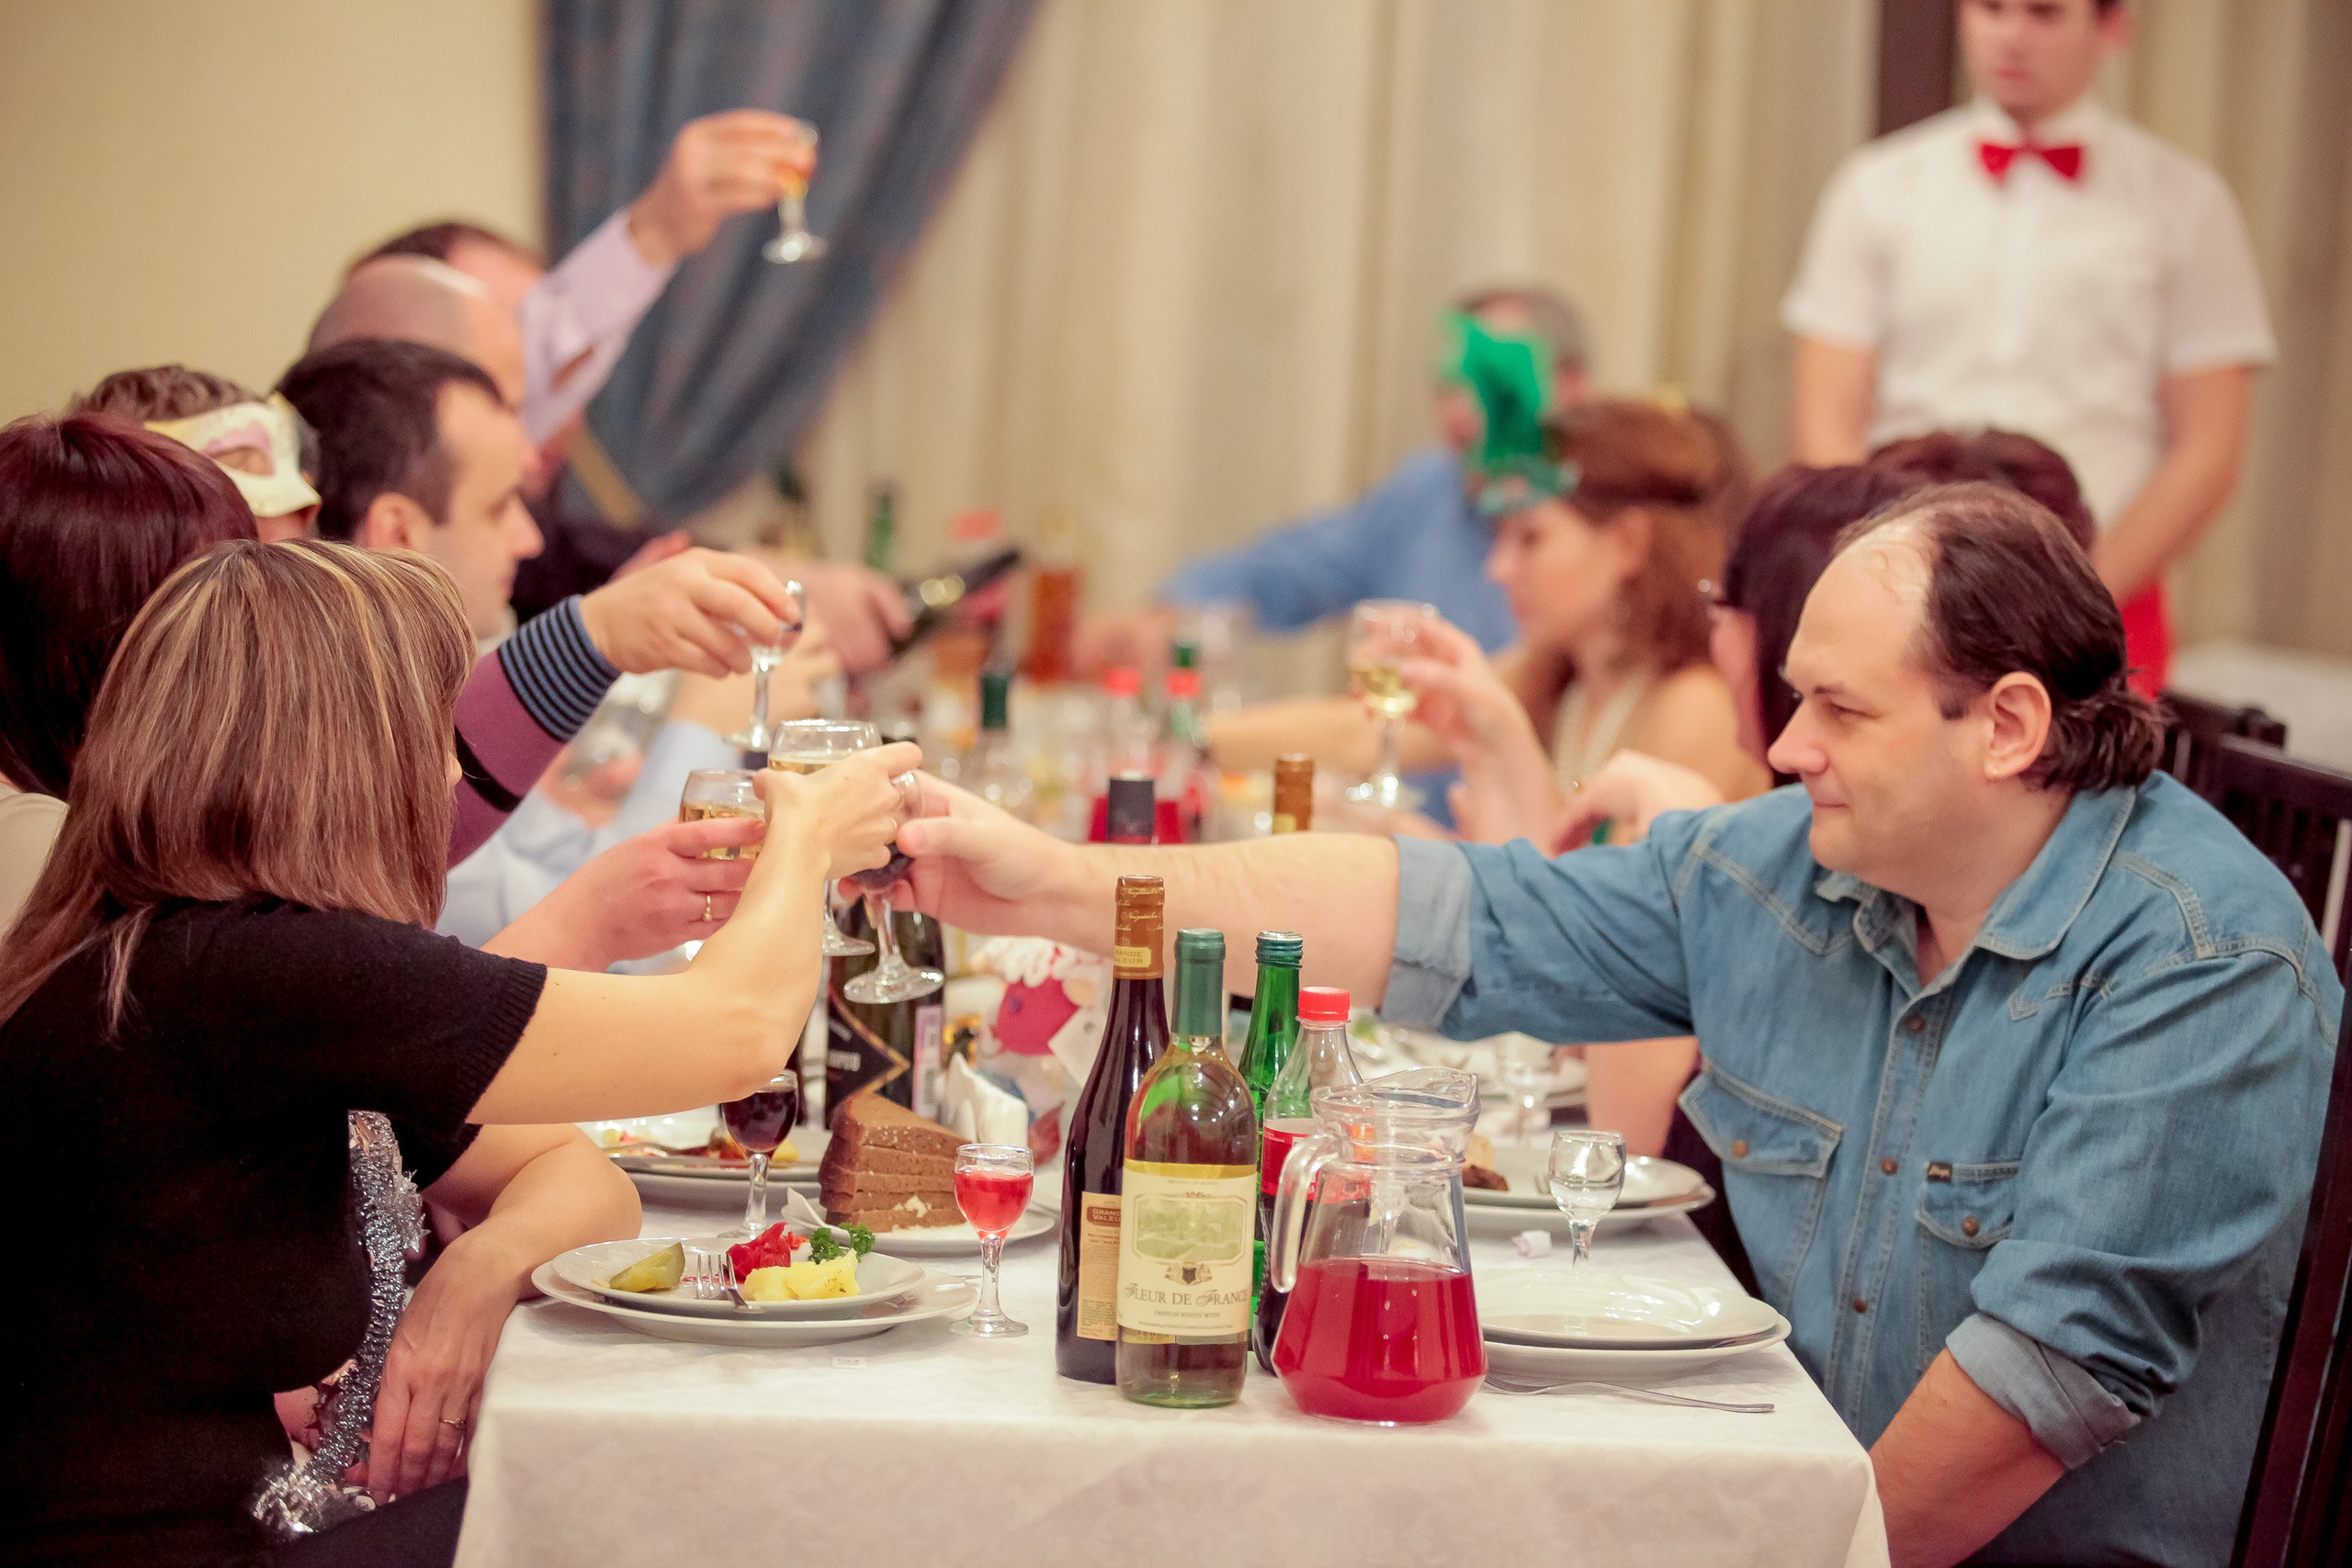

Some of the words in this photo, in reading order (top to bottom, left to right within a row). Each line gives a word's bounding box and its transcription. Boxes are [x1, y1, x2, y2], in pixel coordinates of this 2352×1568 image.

[1114, 949, 1143, 957] RANDE
[1125, 1282, 1166, 1304] FLEUR
[1172, 1292, 1192, 1305] DE
[1196, 1289, 1249, 1306] FRANCE
